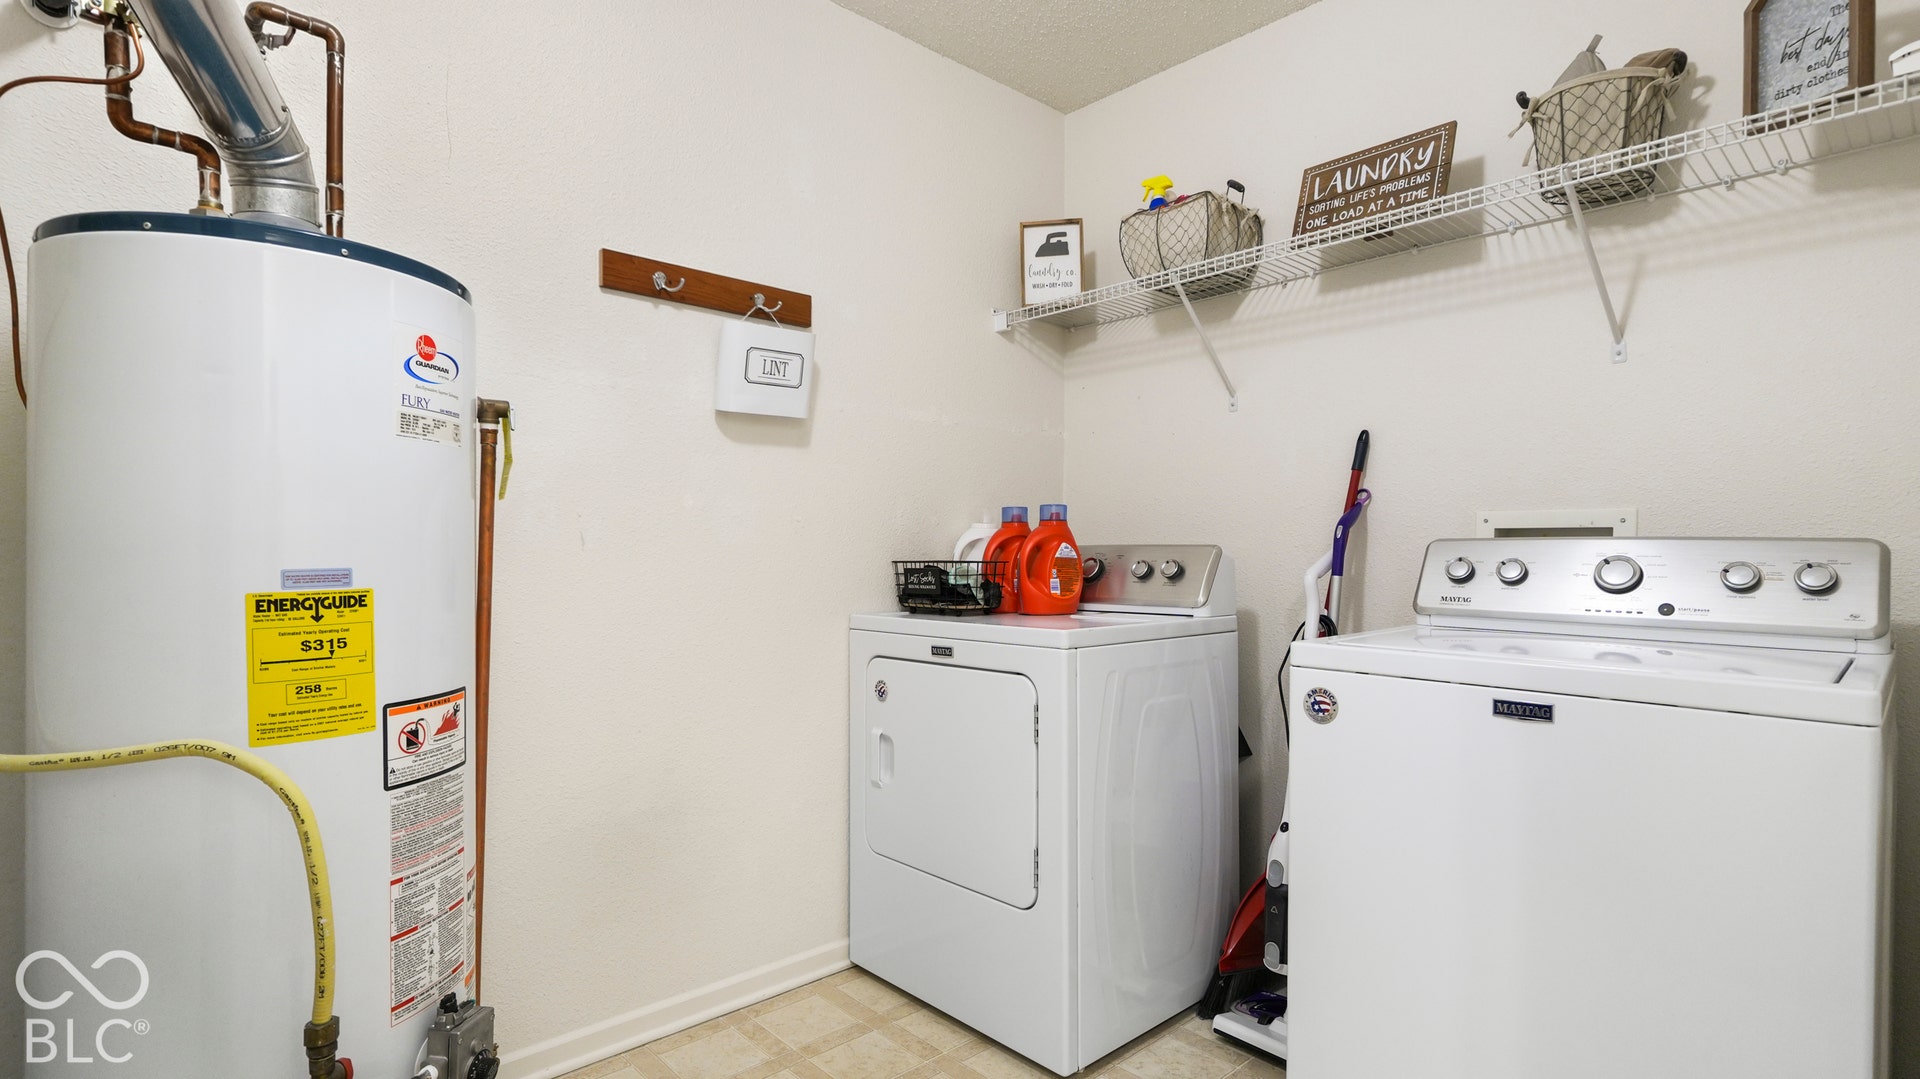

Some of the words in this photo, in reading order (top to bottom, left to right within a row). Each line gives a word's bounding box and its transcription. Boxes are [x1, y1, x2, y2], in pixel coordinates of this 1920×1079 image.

[1830, 3, 1849, 17] The
[1780, 27, 1821, 64] best
[1807, 56, 1827, 72] end
[1774, 83, 1802, 101] dirty
[1807, 66, 1850, 88] clothes
[1313, 141, 1435, 200] LAUNDRY
[1309, 197, 1345, 215] SORTING
[1350, 188, 1376, 204] LIFE'S
[1379, 172, 1431, 195] PROBLEMS
[1306, 215, 1328, 229] ONE
[1333, 205, 1363, 223] LOAD
[1367, 199, 1383, 214] AT
[1386, 197, 1396, 208] A
[1399, 187, 1429, 204] TIME
[415, 360, 450, 374] GUARDIAN
[762, 358, 789, 378] LINT
[401, 393, 431, 409] FURY
[255, 594, 368, 613] ENERGYGUIDE
[300, 637, 348, 653] $315
[932, 648, 952, 656] MAYTAG
[295, 684, 322, 695] 258
[1307, 688, 1337, 706] AMERICA
[424, 697, 451, 709] WARNING
[1496, 703, 1551, 718] MAYTAG
